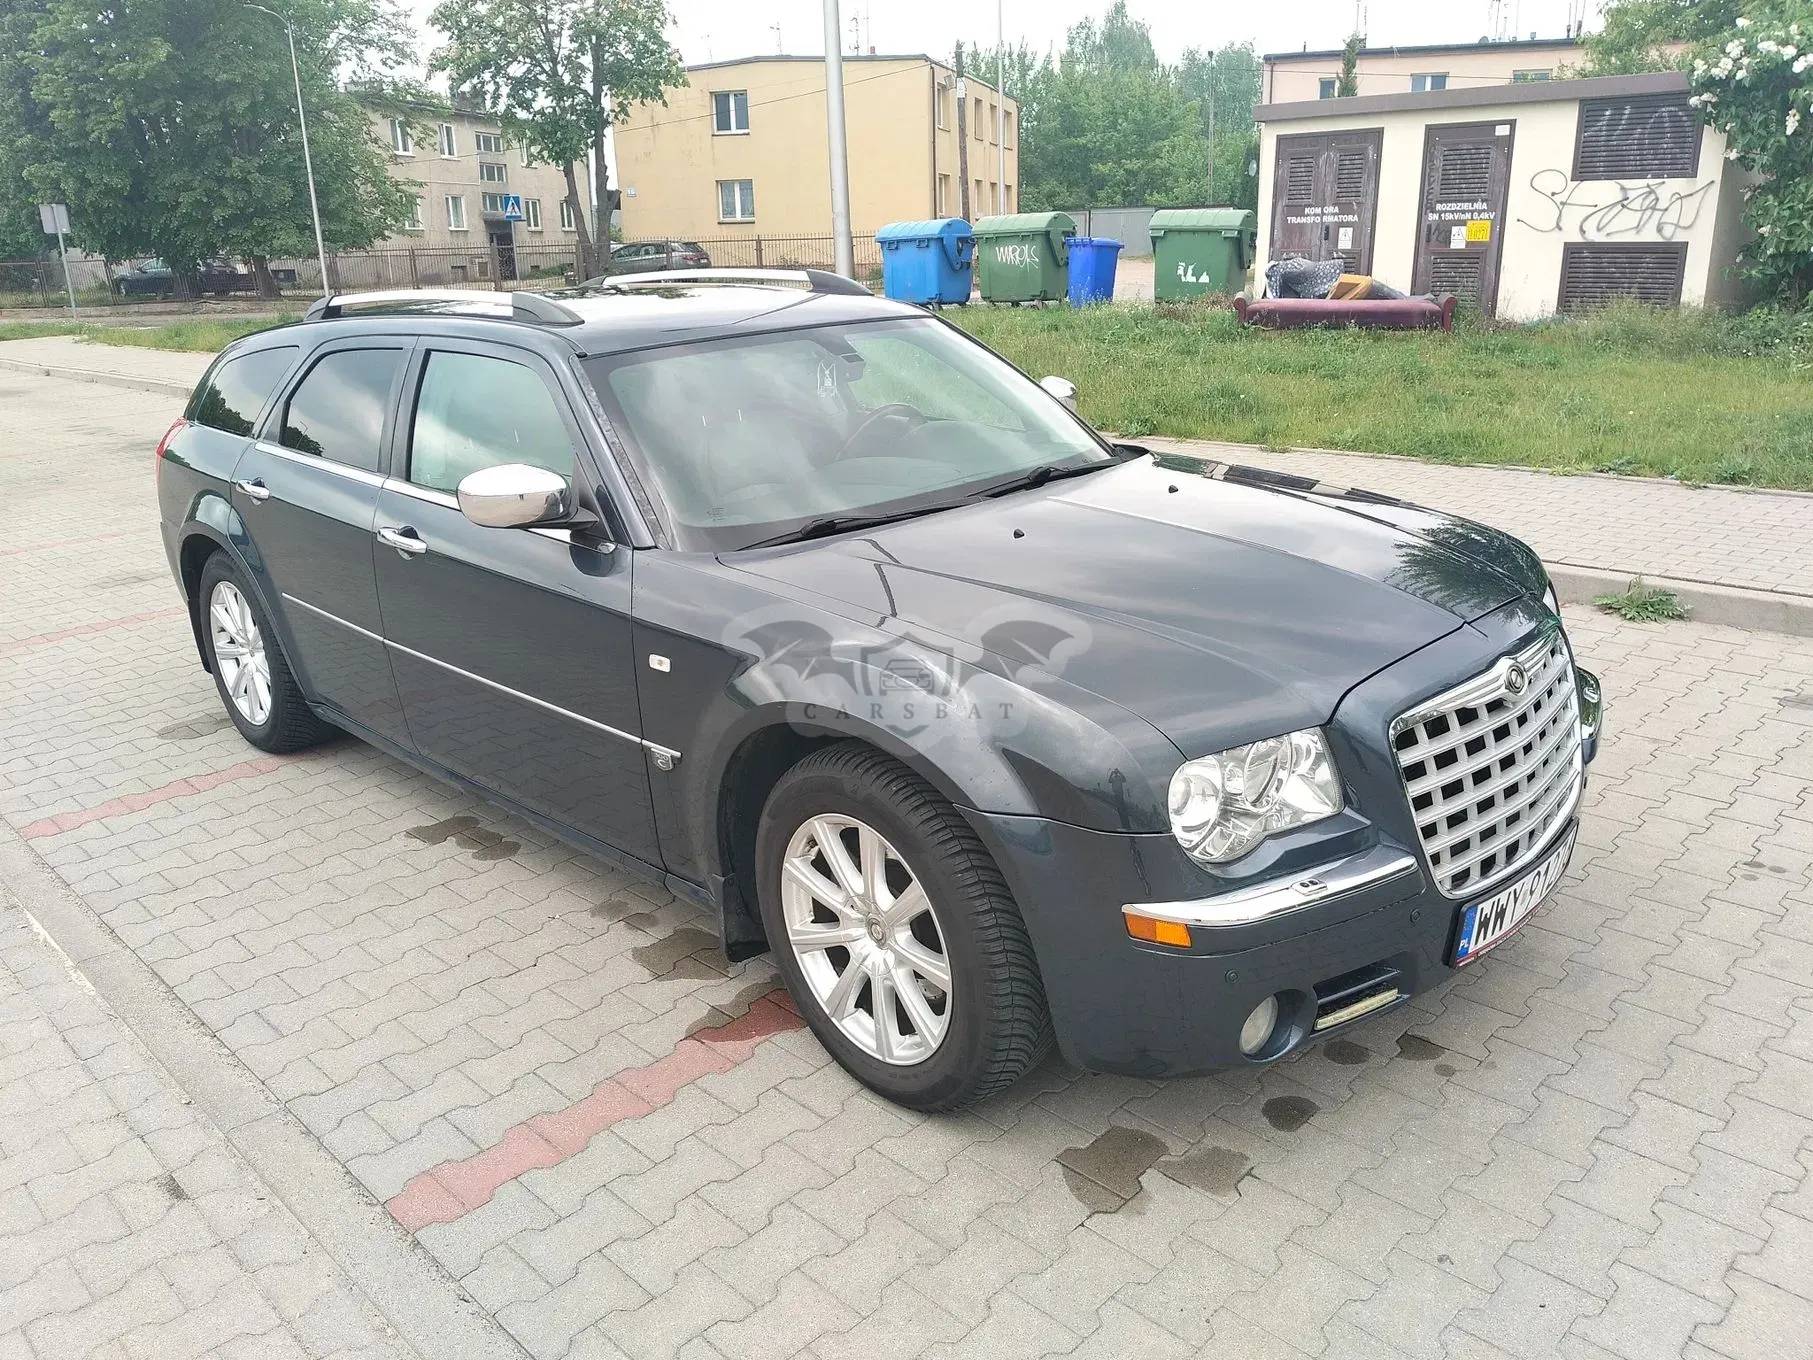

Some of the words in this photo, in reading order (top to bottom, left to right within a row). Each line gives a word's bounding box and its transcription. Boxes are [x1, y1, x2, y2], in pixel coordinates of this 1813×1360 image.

[1436, 202, 1487, 210] ROZDZIELNIA
[1473, 212, 1495, 220] 0,4kV
[1475, 881, 1525, 946] WWY
[1459, 939, 1468, 951] PL
